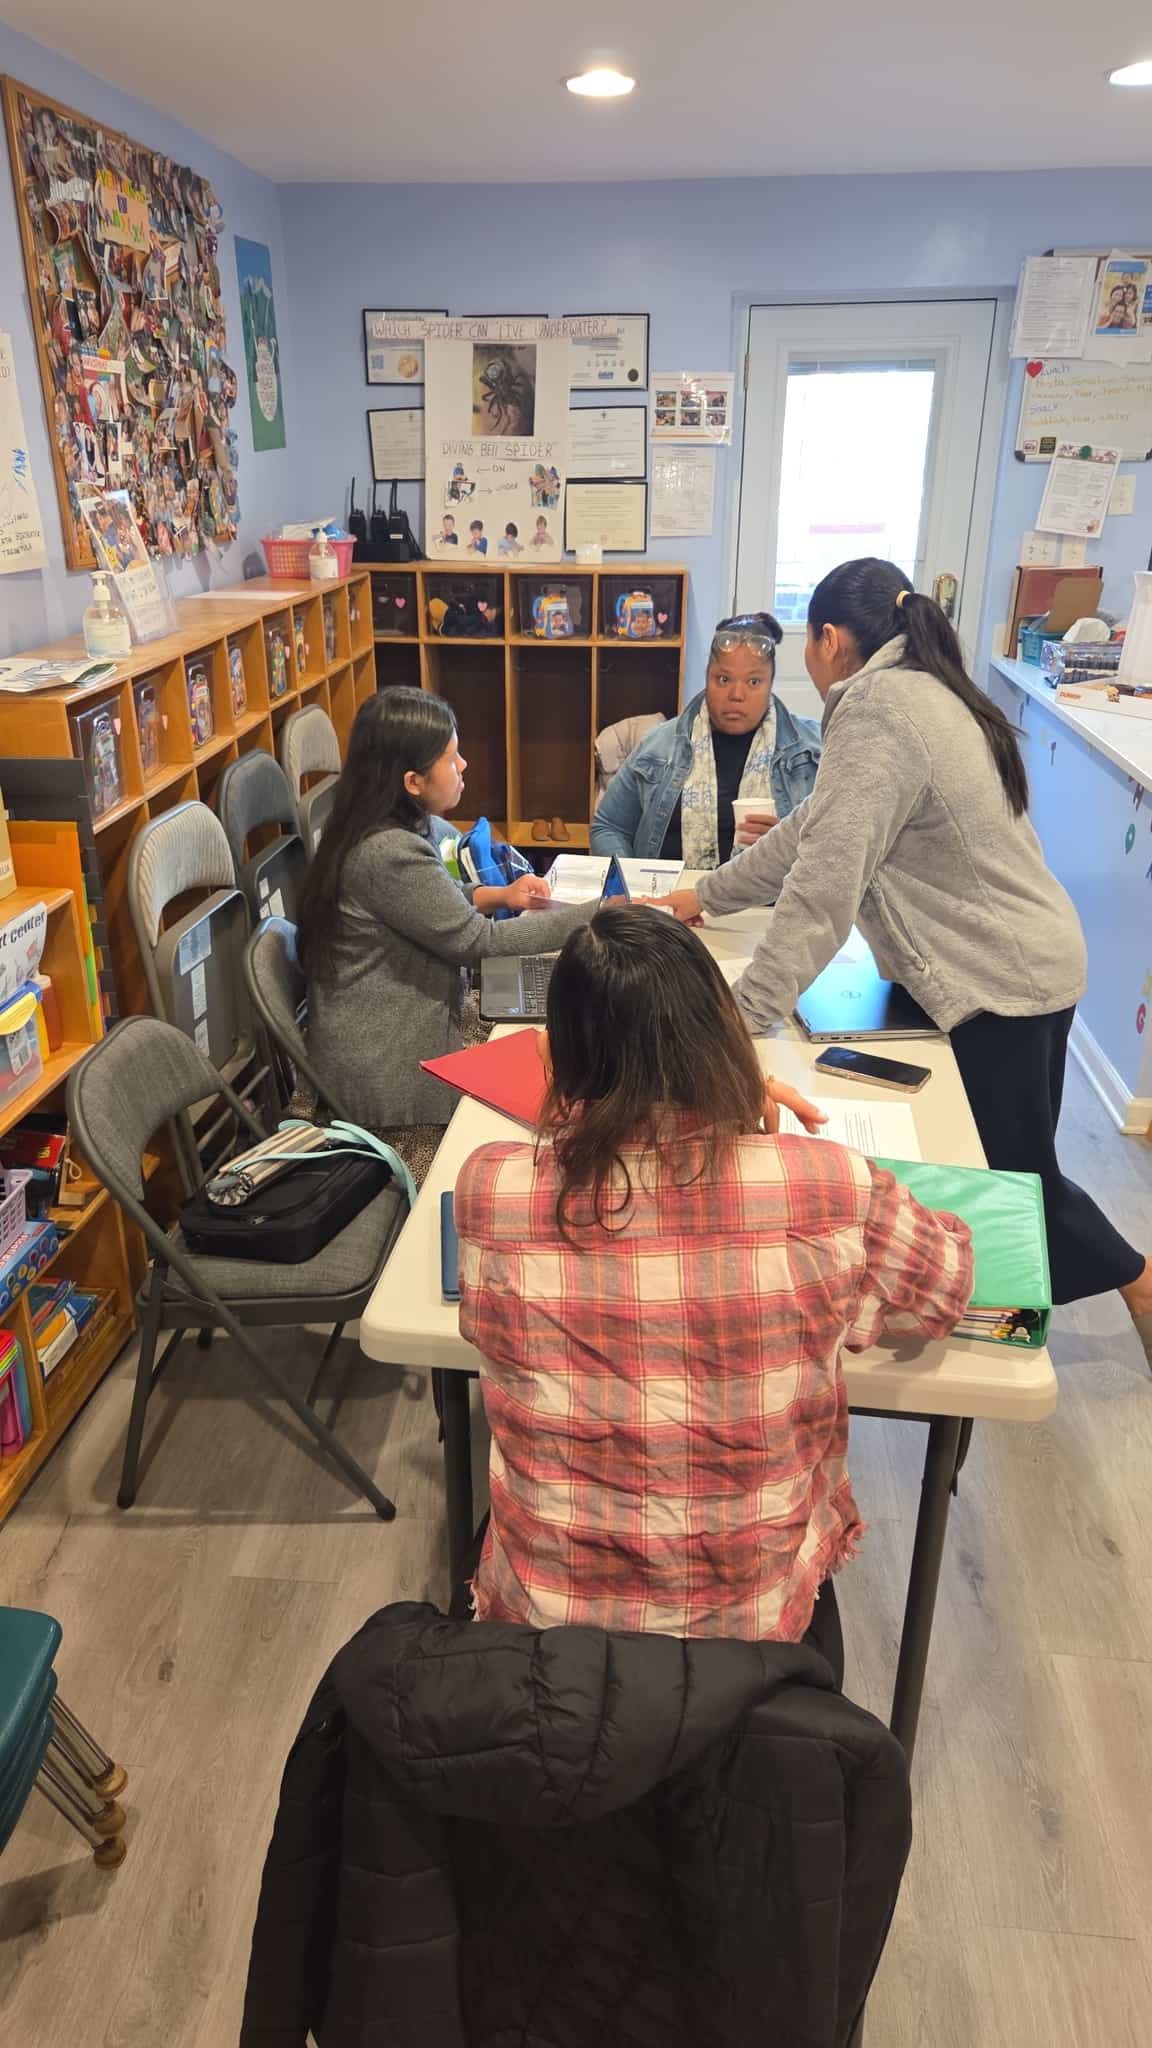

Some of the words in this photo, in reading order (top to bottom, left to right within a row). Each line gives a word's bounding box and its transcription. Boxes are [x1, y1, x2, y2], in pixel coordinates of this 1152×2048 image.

[422, 320, 463, 337] SPIDER
[468, 320, 488, 337] CAN
[504, 442, 553, 457] SPIDER
[10, 911, 46, 943] center
